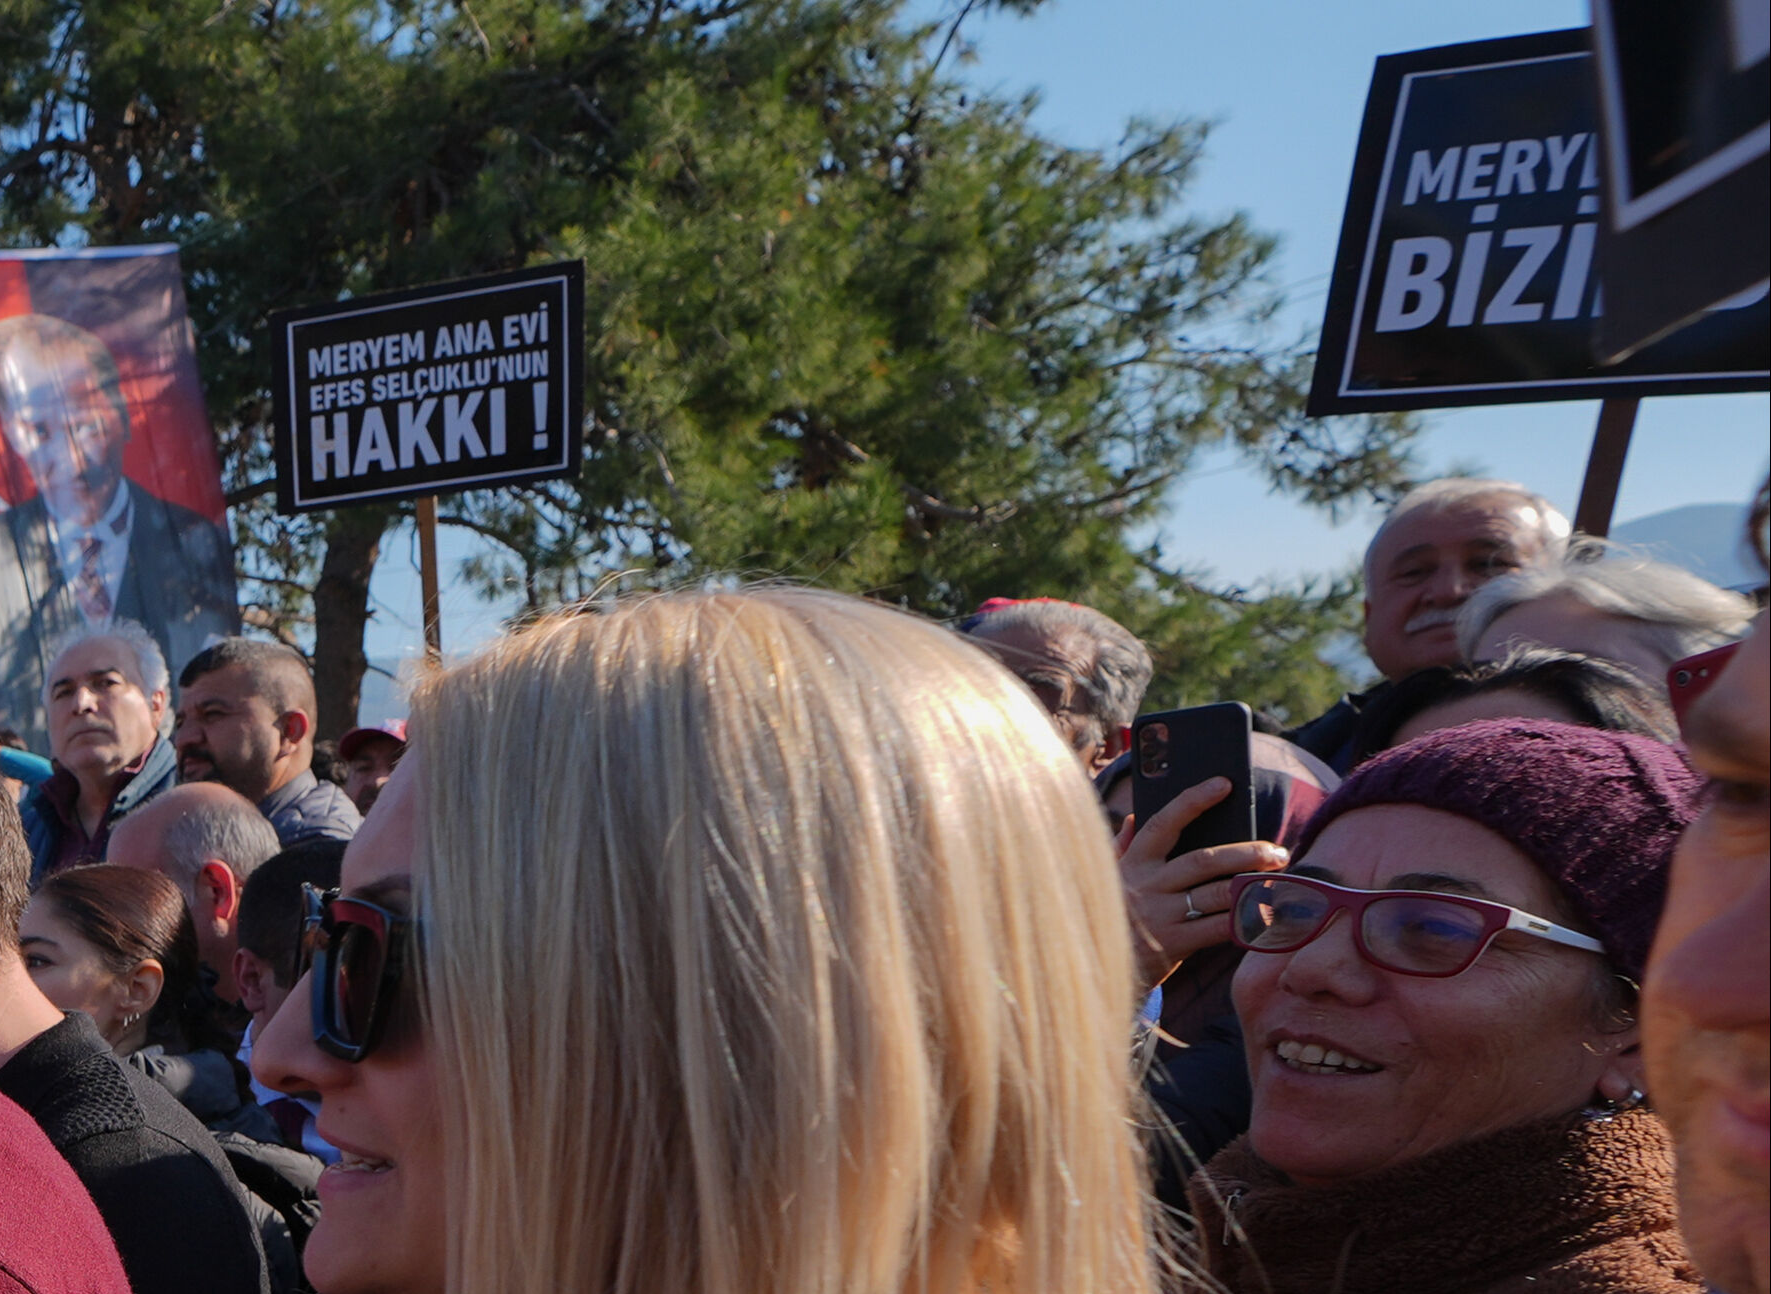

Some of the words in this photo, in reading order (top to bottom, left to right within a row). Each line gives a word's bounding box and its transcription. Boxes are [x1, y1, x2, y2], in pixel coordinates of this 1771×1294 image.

[1375, 196, 1604, 333] BİZİ
[308, 330, 426, 380] MERYEM
[433, 320, 495, 359] ANA
[503, 301, 549, 348] EVİ
[310, 378, 366, 412] EFES
[311, 387, 507, 482] HAKKI
[532, 381, 549, 450] !
